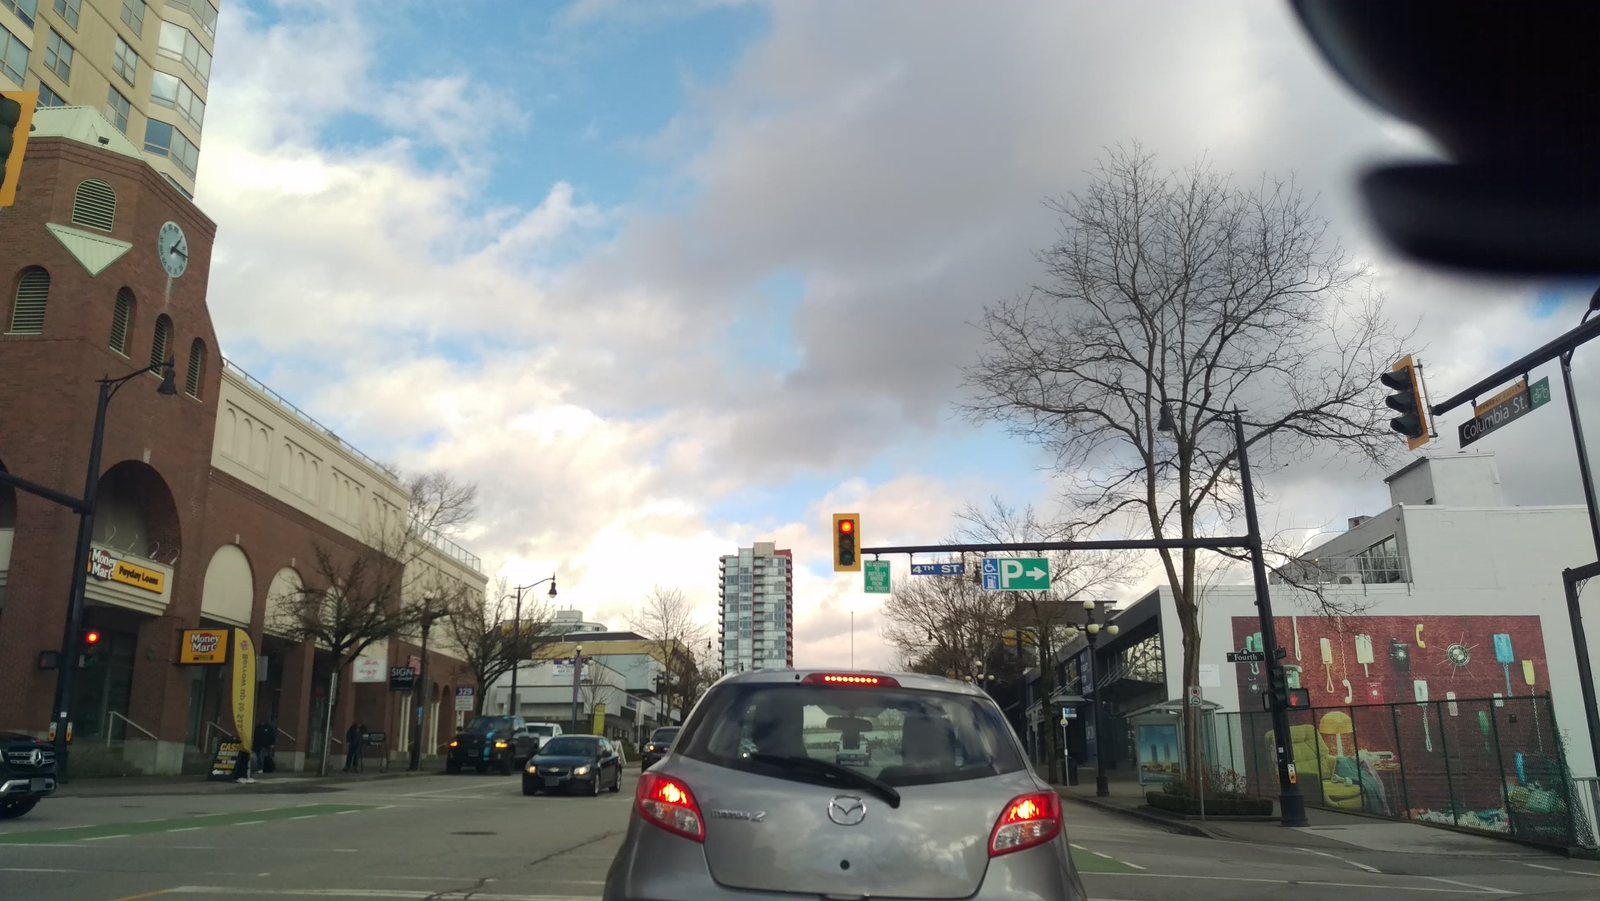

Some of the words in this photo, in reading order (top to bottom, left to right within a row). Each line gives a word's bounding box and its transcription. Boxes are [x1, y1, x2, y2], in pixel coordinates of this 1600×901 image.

[1463, 406, 1510, 440] Columbia
[1513, 395, 1528, 414] St.
[92, 548, 117, 569] Money
[91, 561, 113, 580] Mart
[119, 565, 141, 582] Payday
[142, 572, 158, 585] Loans
[912, 565, 934, 573] 4TH
[941, 565, 963, 573] ST.
[1000, 560, 1023, 588] P
[191, 634, 220, 643] Money
[191, 643, 216, 652] Mart
[1234, 653, 1257, 661] Fourth
[391, 667, 413, 677] SIGN
